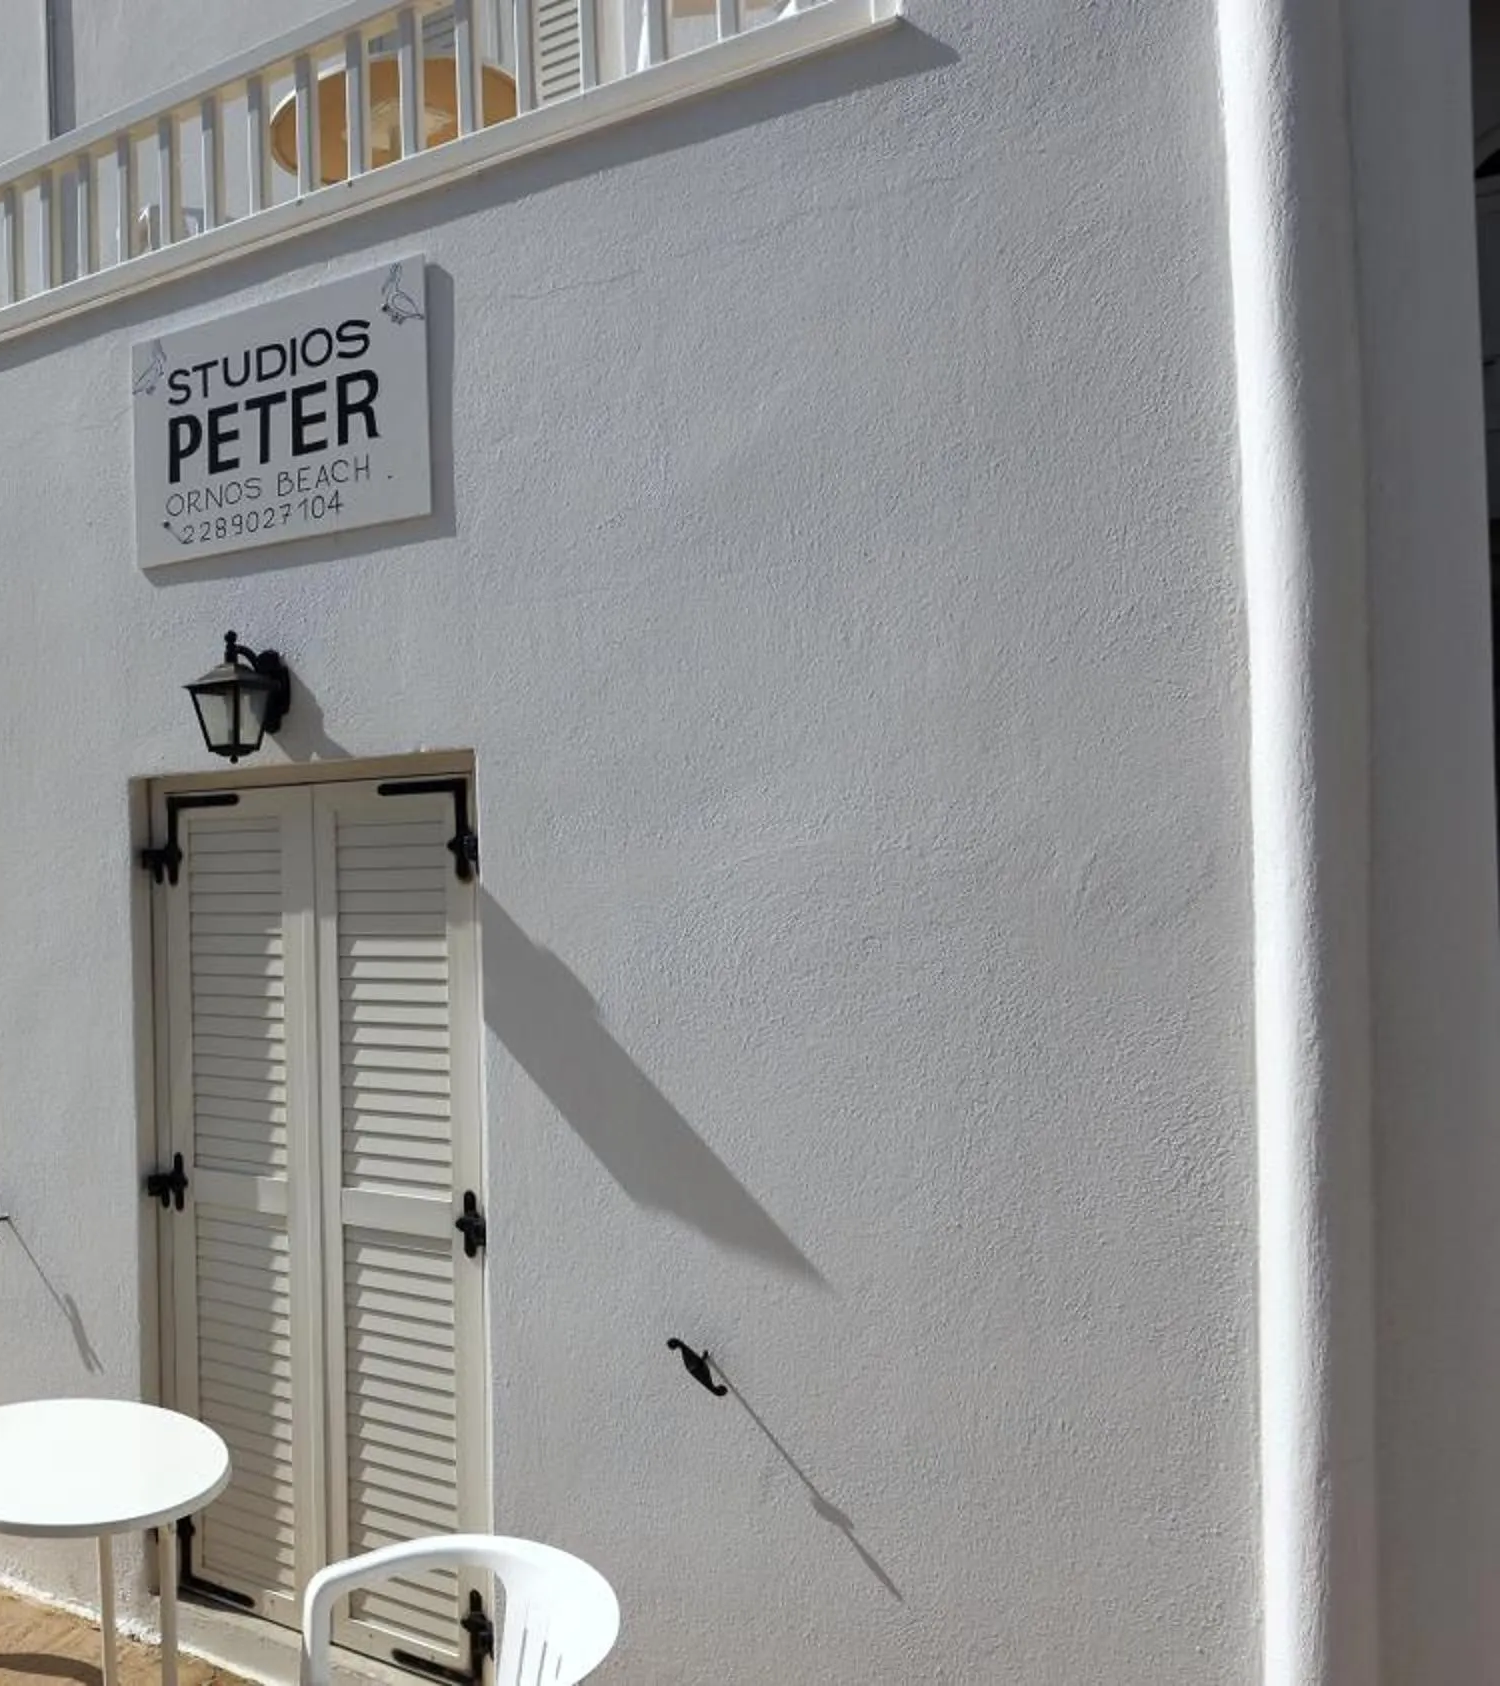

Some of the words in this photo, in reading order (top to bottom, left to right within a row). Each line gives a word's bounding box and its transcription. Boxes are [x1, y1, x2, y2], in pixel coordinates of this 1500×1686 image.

[167, 318, 371, 406] STUDIOS
[168, 369, 380, 484] PETER
[165, 476, 262, 518] ORNOS
[276, 454, 371, 497] BEACH
[181, 490, 344, 545] 2289027104
